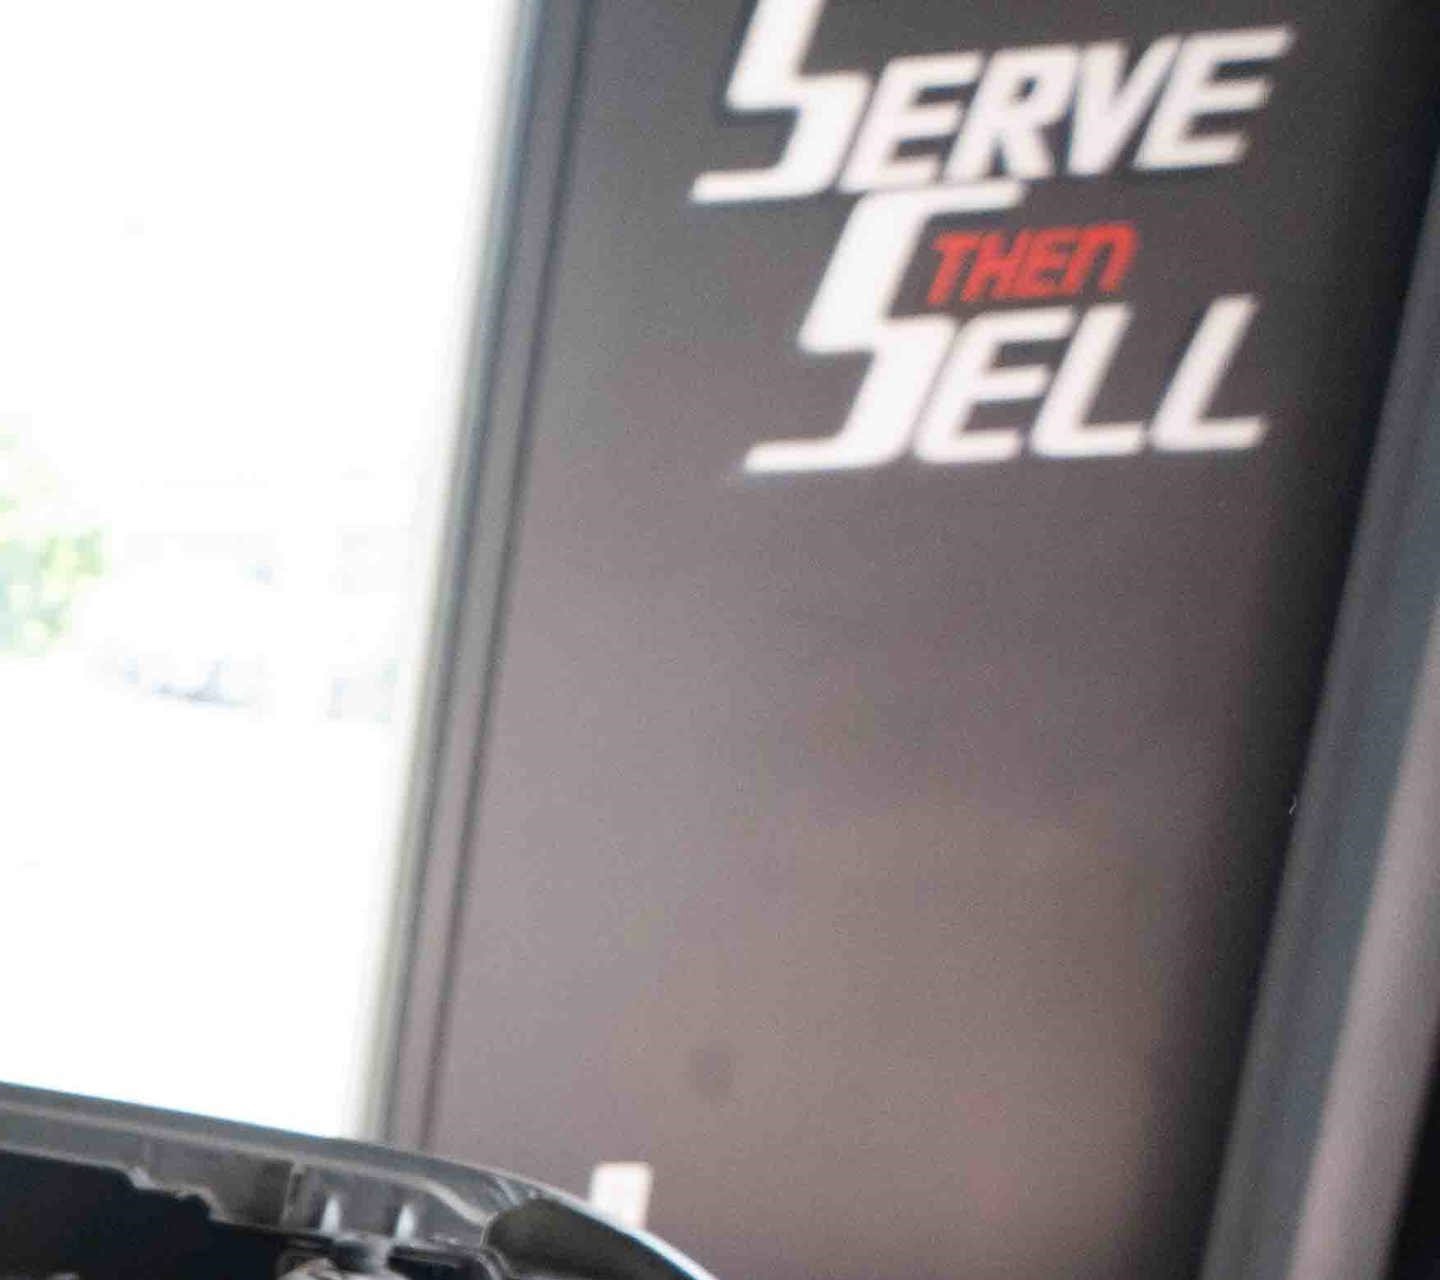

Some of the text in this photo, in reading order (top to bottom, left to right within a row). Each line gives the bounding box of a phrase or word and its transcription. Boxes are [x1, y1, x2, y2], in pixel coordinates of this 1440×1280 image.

[690, 0, 1293, 201] SERVE
[742, 179, 1270, 474] SELL
[926, 222, 1139, 305] THEN
